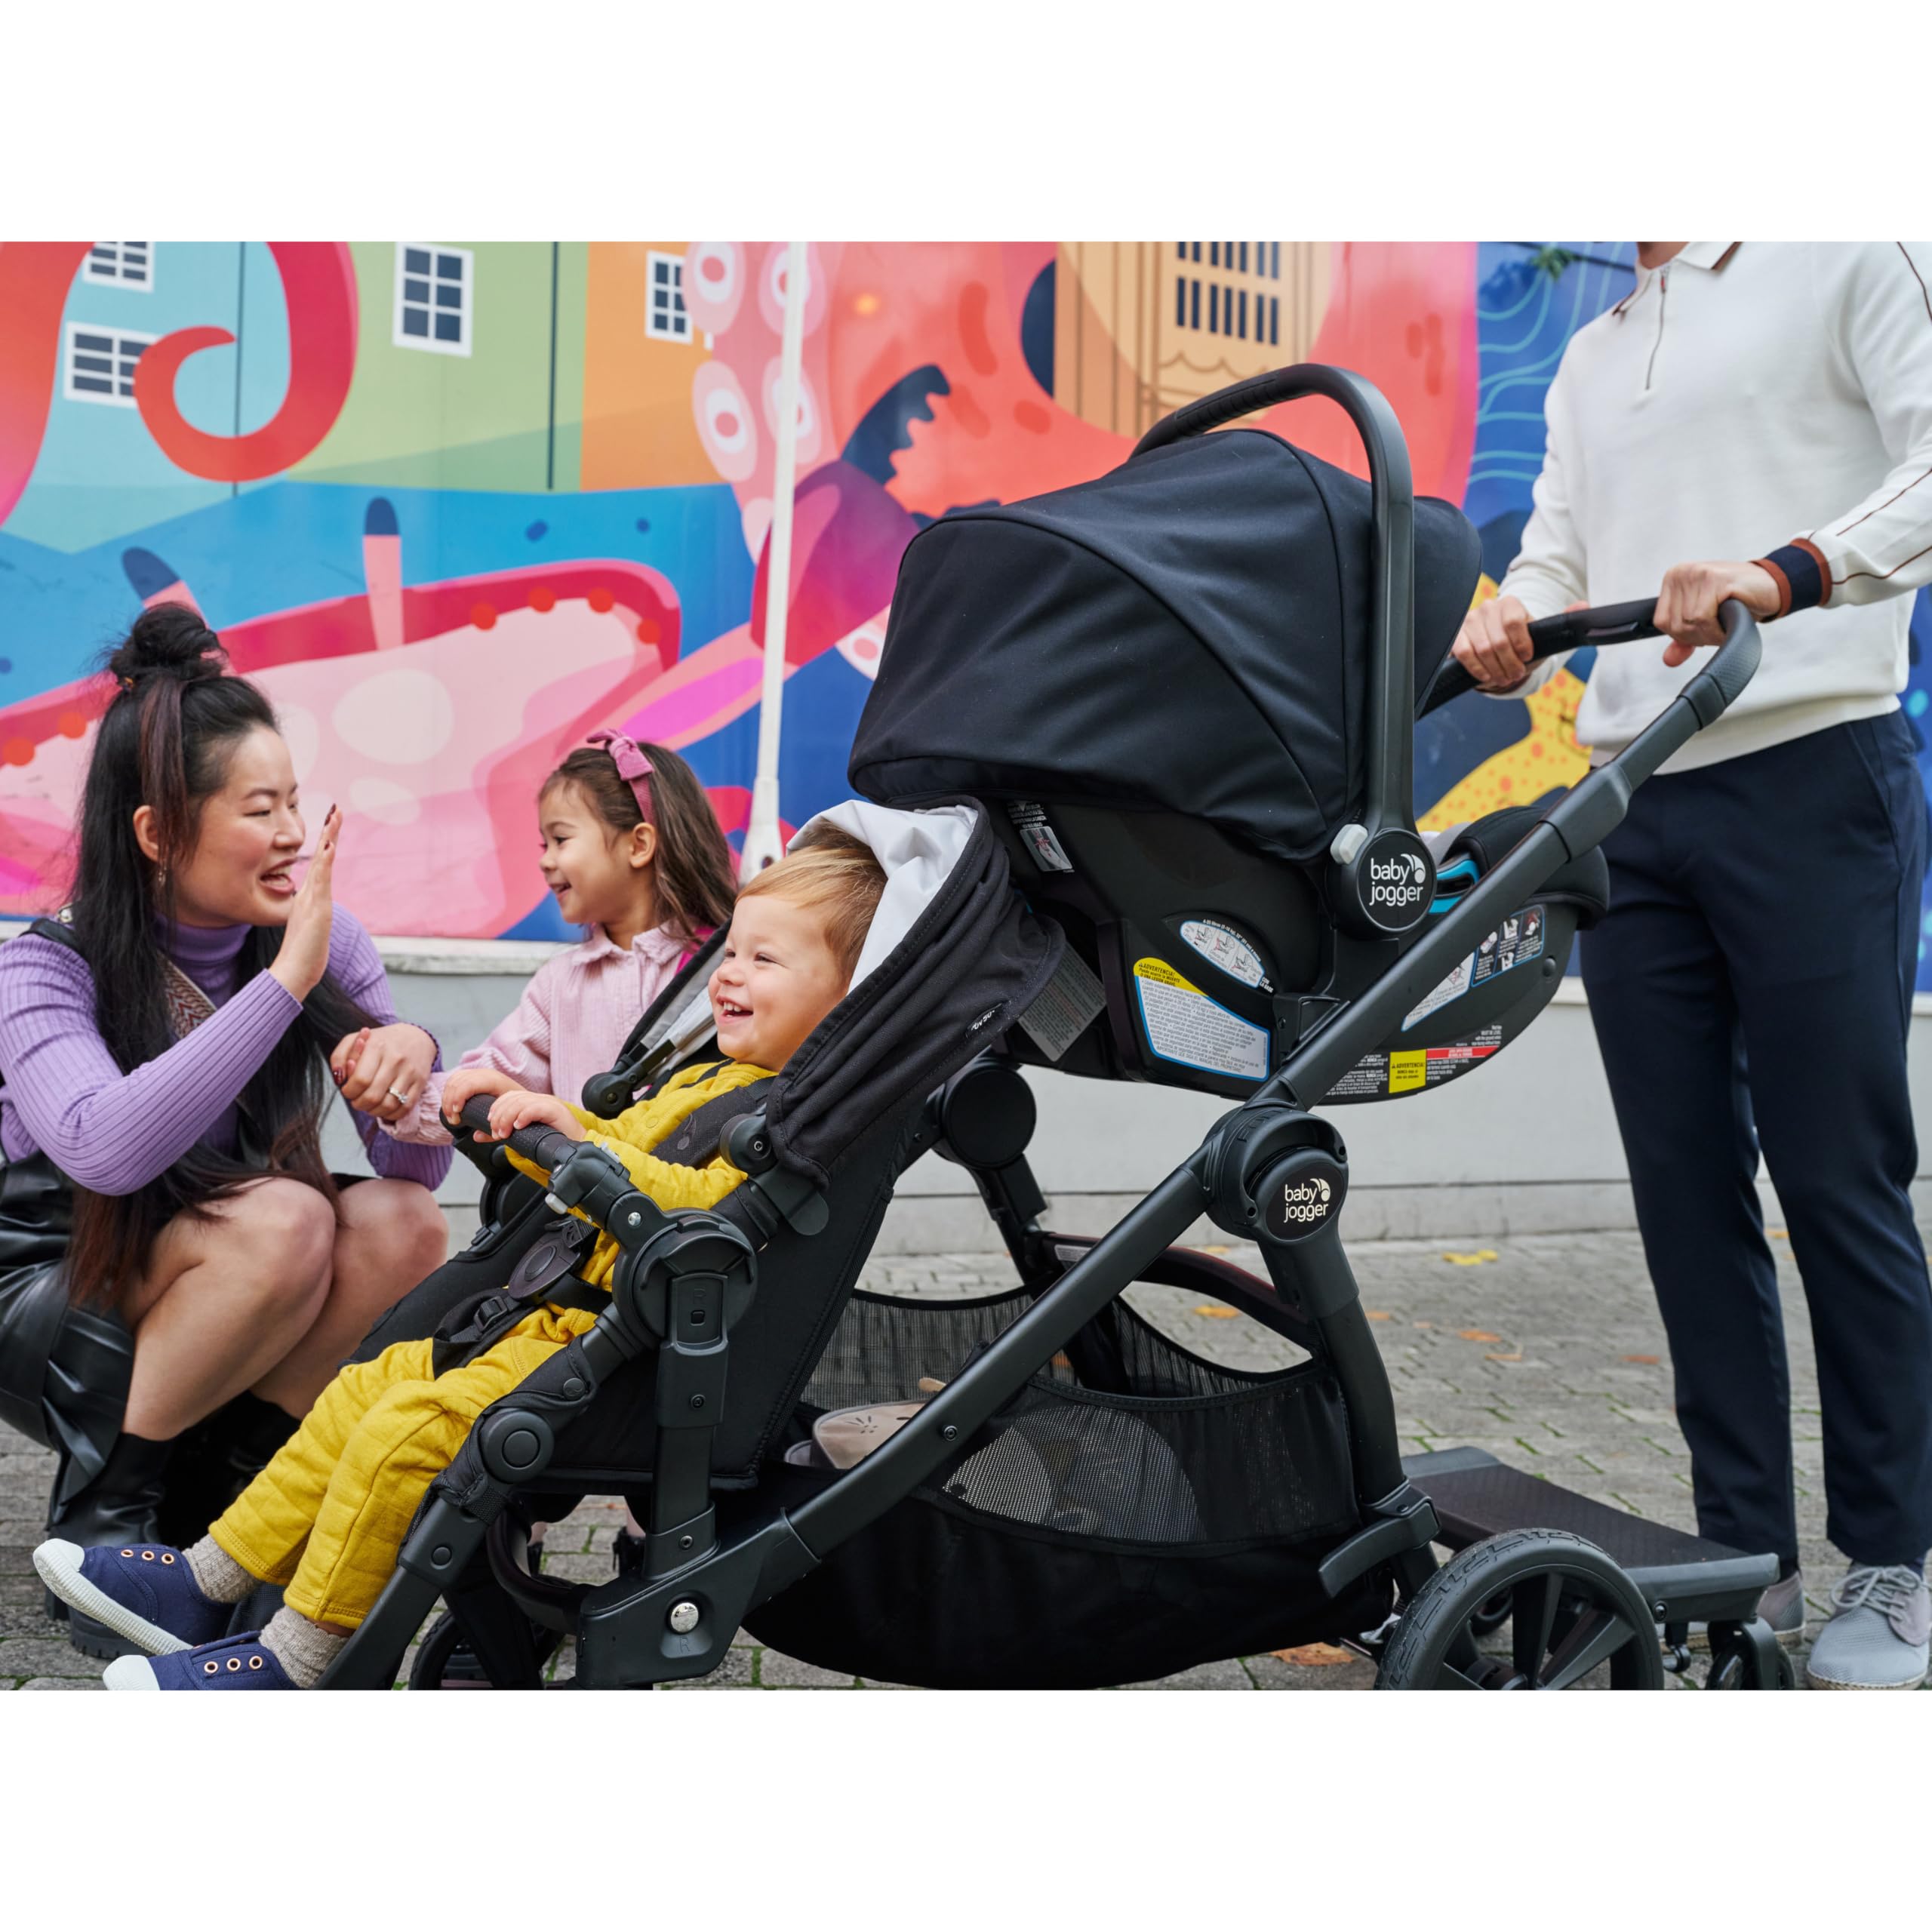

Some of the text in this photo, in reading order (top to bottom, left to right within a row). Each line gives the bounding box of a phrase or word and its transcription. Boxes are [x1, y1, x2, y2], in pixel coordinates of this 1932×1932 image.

[1371, 857, 1410, 885] baby
[1369, 881, 1423, 906] jogger
[1284, 1183, 1318, 1204] baby
[1283, 1203, 1329, 1223] jogger
